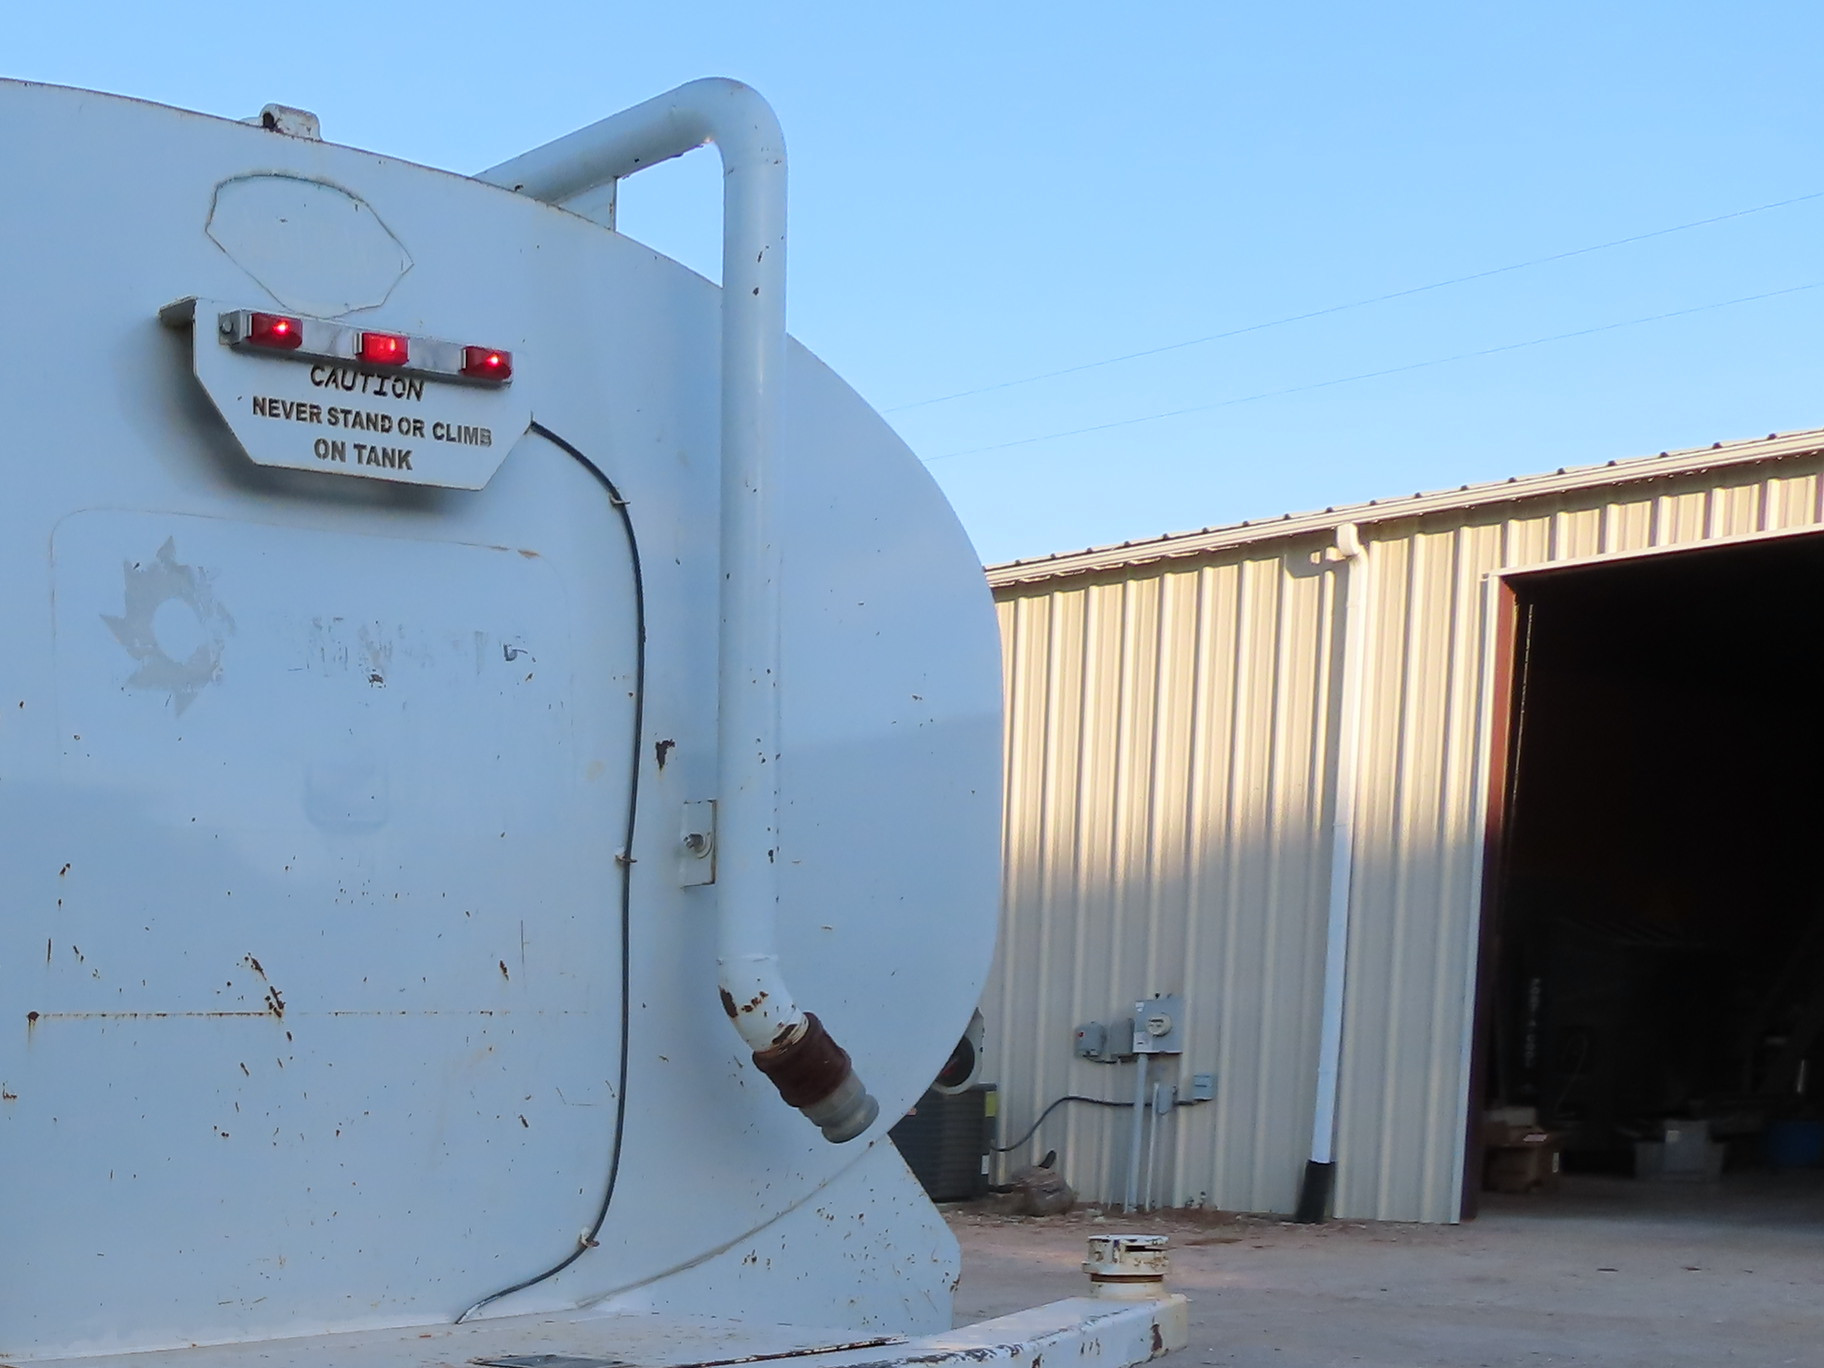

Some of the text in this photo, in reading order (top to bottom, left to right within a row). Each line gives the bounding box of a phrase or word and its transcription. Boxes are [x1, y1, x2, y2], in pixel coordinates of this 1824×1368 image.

[310, 364, 424, 401] CAUTION
[253, 396, 491, 446] NEVER STAND OR CLIMB
[314, 438, 412, 470] ON TANK
